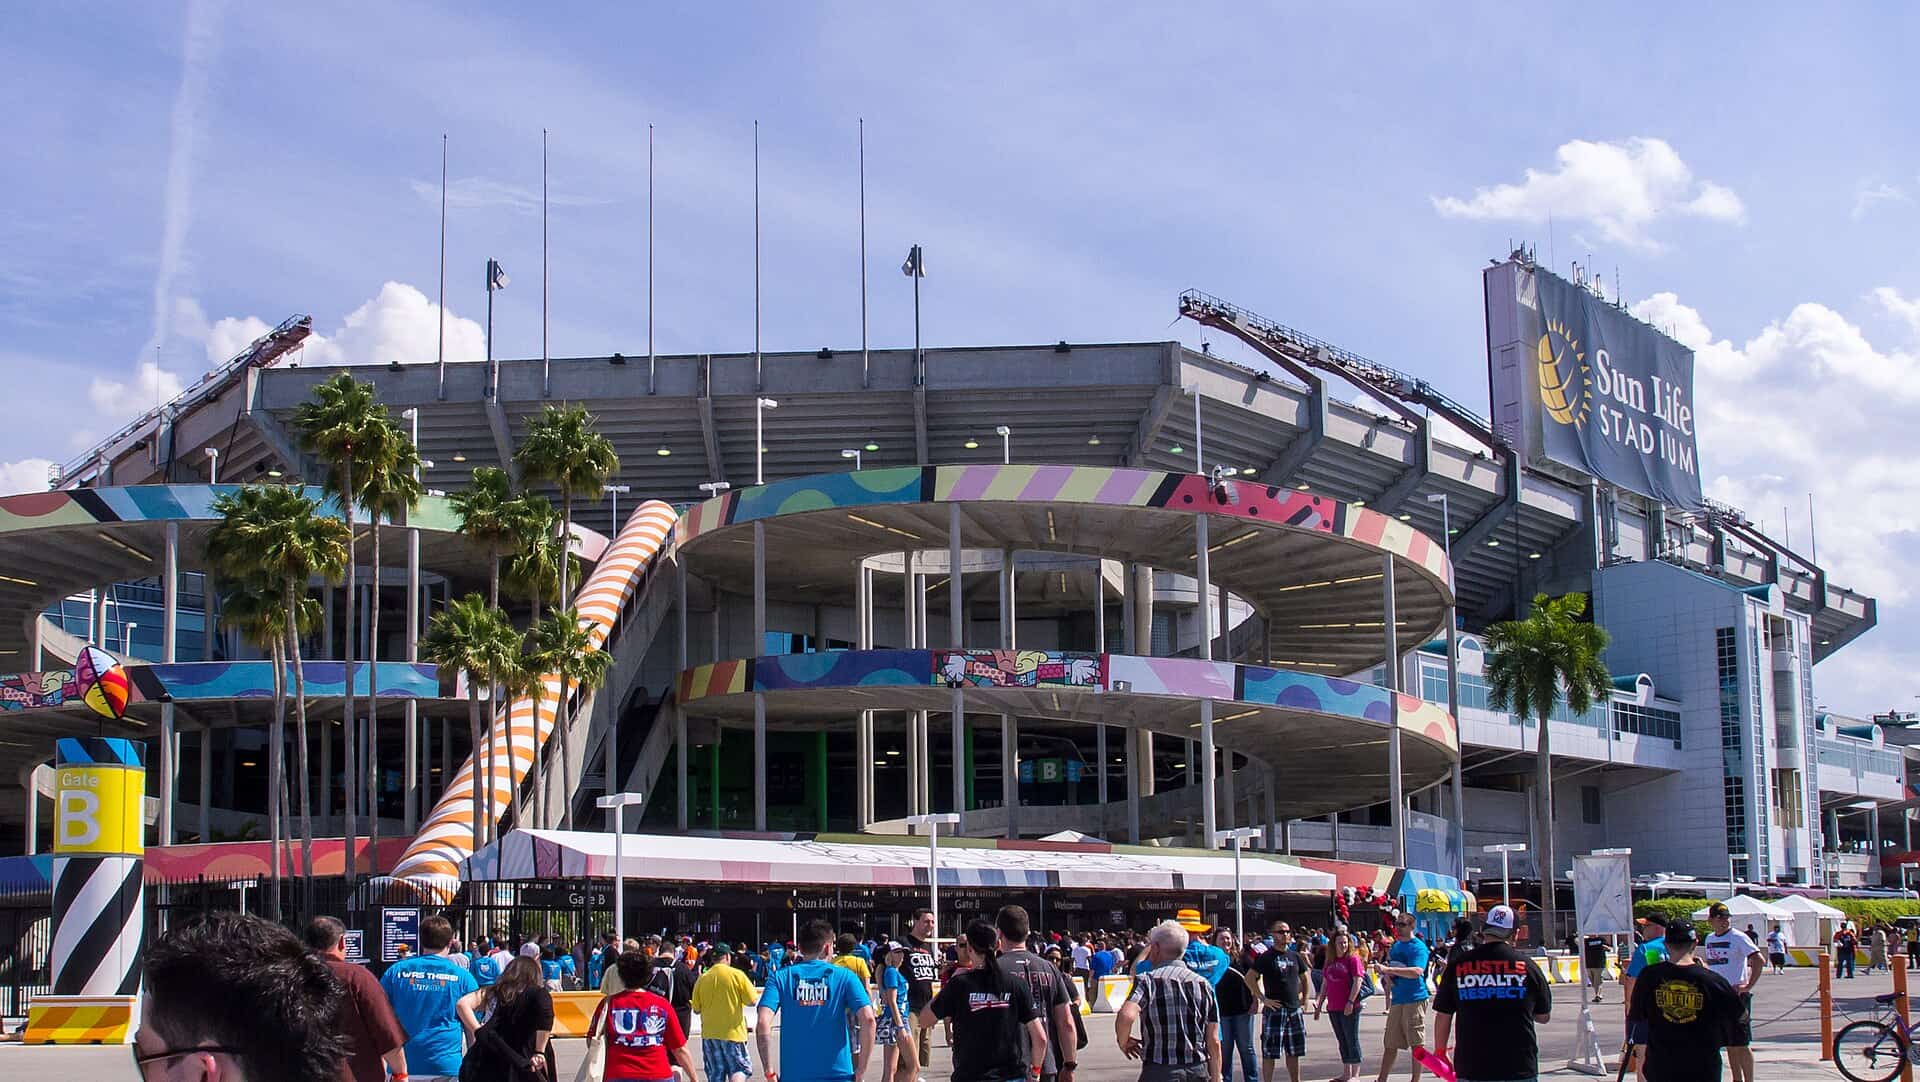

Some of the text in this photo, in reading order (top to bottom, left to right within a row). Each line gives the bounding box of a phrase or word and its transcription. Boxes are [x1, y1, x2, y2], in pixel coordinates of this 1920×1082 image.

[1596, 349, 1692, 436] Sun Life
[1600, 404, 1694, 475] STADIUM
[1043, 762, 1057, 780] B
[62, 772, 98, 787] Gate
[60, 790, 100, 846] B
[568, 893, 606, 905] Gae B
[661, 895, 705, 907] Welcome
[797, 897, 817, 909] Sun
[818, 896, 837, 909] Life
[402, 971, 425, 979] WAS
[1456, 974, 1527, 989] LOYALTY
[796, 985, 828, 1001] MIAMI
[1458, 986, 1527, 1001] RESPECT
[612, 1009, 640, 1034] U
